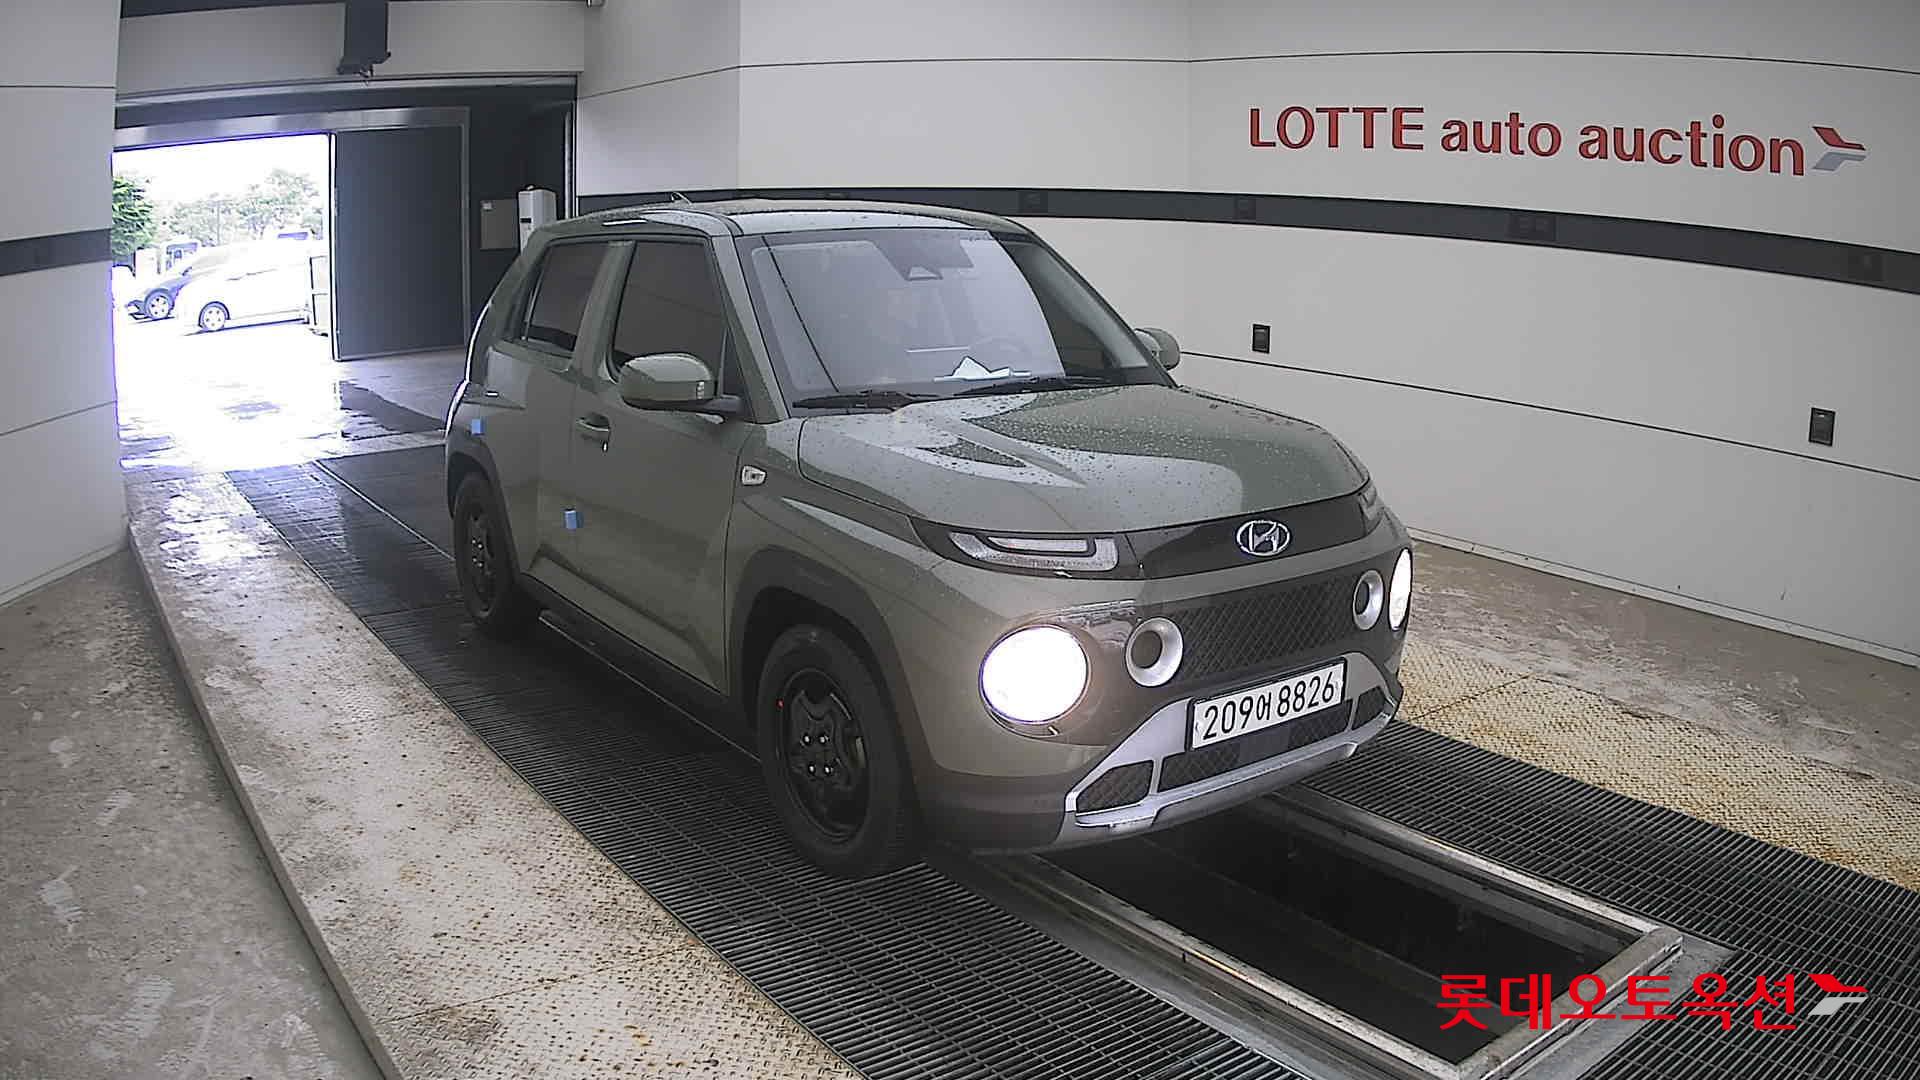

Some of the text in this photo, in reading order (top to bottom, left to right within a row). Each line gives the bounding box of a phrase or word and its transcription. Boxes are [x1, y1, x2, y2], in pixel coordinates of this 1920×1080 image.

[1249, 106, 1805, 176] LOTTE auto auction
